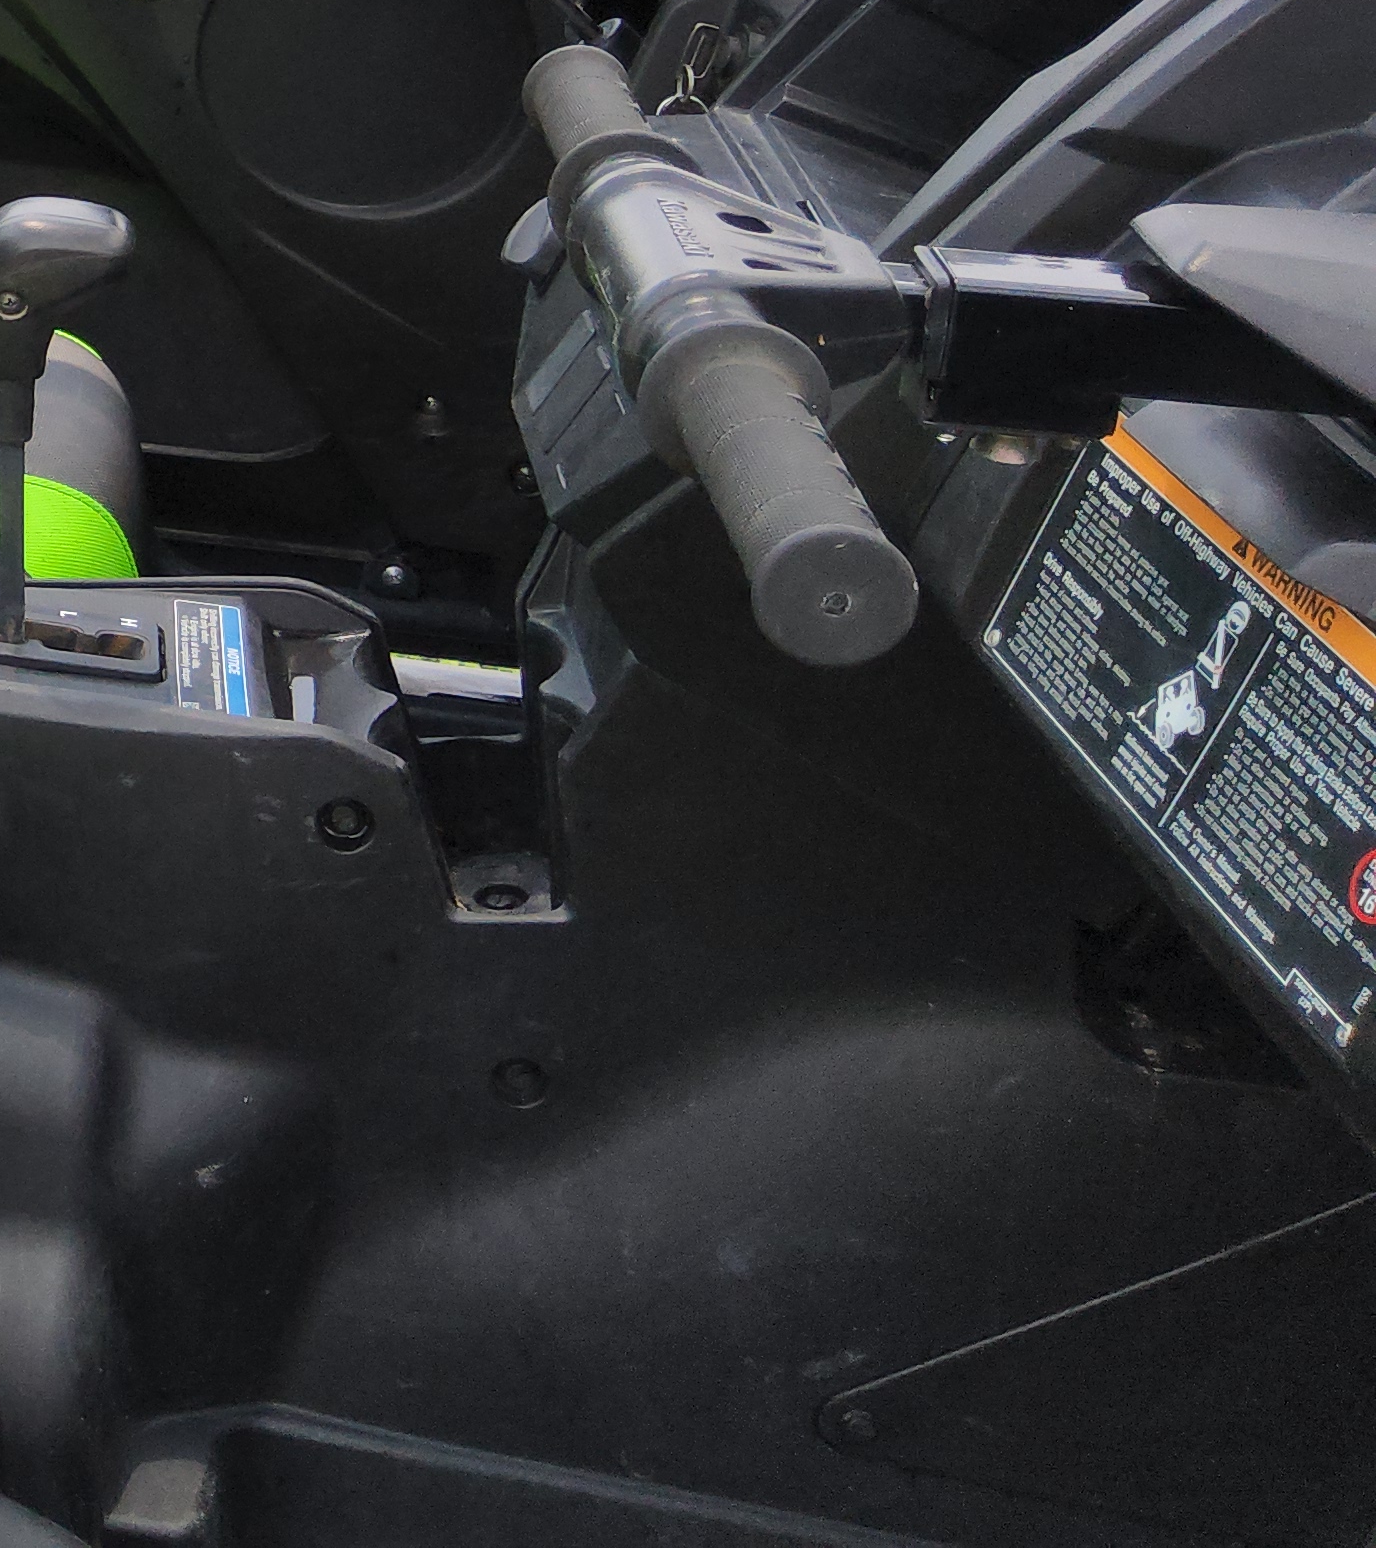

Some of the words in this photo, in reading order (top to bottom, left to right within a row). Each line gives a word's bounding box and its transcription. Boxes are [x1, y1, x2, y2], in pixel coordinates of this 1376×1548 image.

[1101, 453, 1141, 495] Improper
[1141, 489, 1160, 514] Use
[1161, 511, 1176, 525] of
[1175, 520, 1231, 580] Off-Highway
[1233, 571, 1274, 618] Vehicles
[1276, 612, 1298, 640] Can
[1300, 635, 1334, 673] Cause
[1335, 667, 1375, 712] Severe
[1252, 547, 1336, 633] WARNING
[119, 617, 138, 628] H
[227, 647, 241, 676] NOTICE
